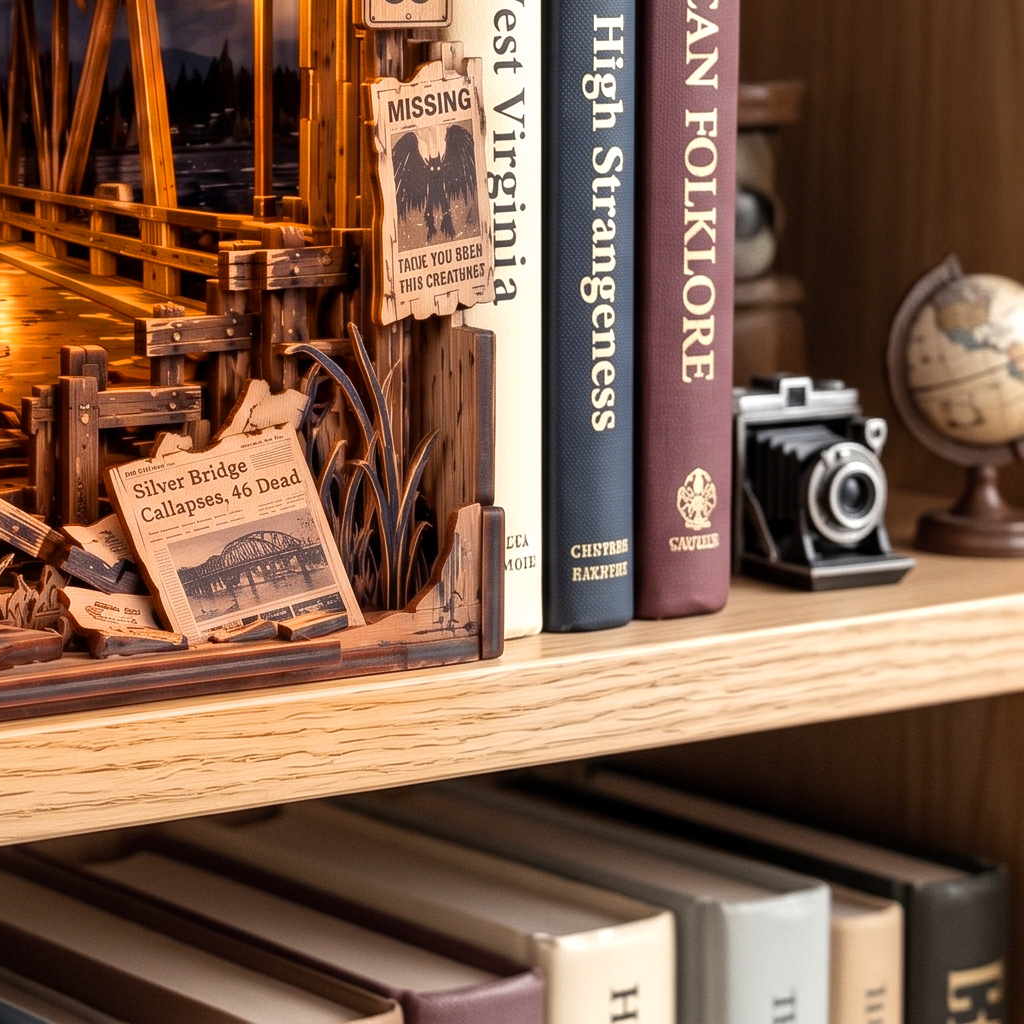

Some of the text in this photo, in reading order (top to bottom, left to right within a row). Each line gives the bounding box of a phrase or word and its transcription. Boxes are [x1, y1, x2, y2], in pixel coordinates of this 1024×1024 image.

[387, 87, 472, 123] MISSING
[582, 11, 625, 131] High
[487, 87, 526, 306] Virginia
[430, 249, 452, 266] YOU
[681, 107, 718, 384] FOLKLORE
[580, 147, 624, 432] Strangeness
[133, 475, 185, 499] Silver
[188, 461, 248, 486] Bridge
[141, 492, 230, 523] Callapses,
[232, 482, 253, 500] 46
[256, 468, 302, 494] Dead
